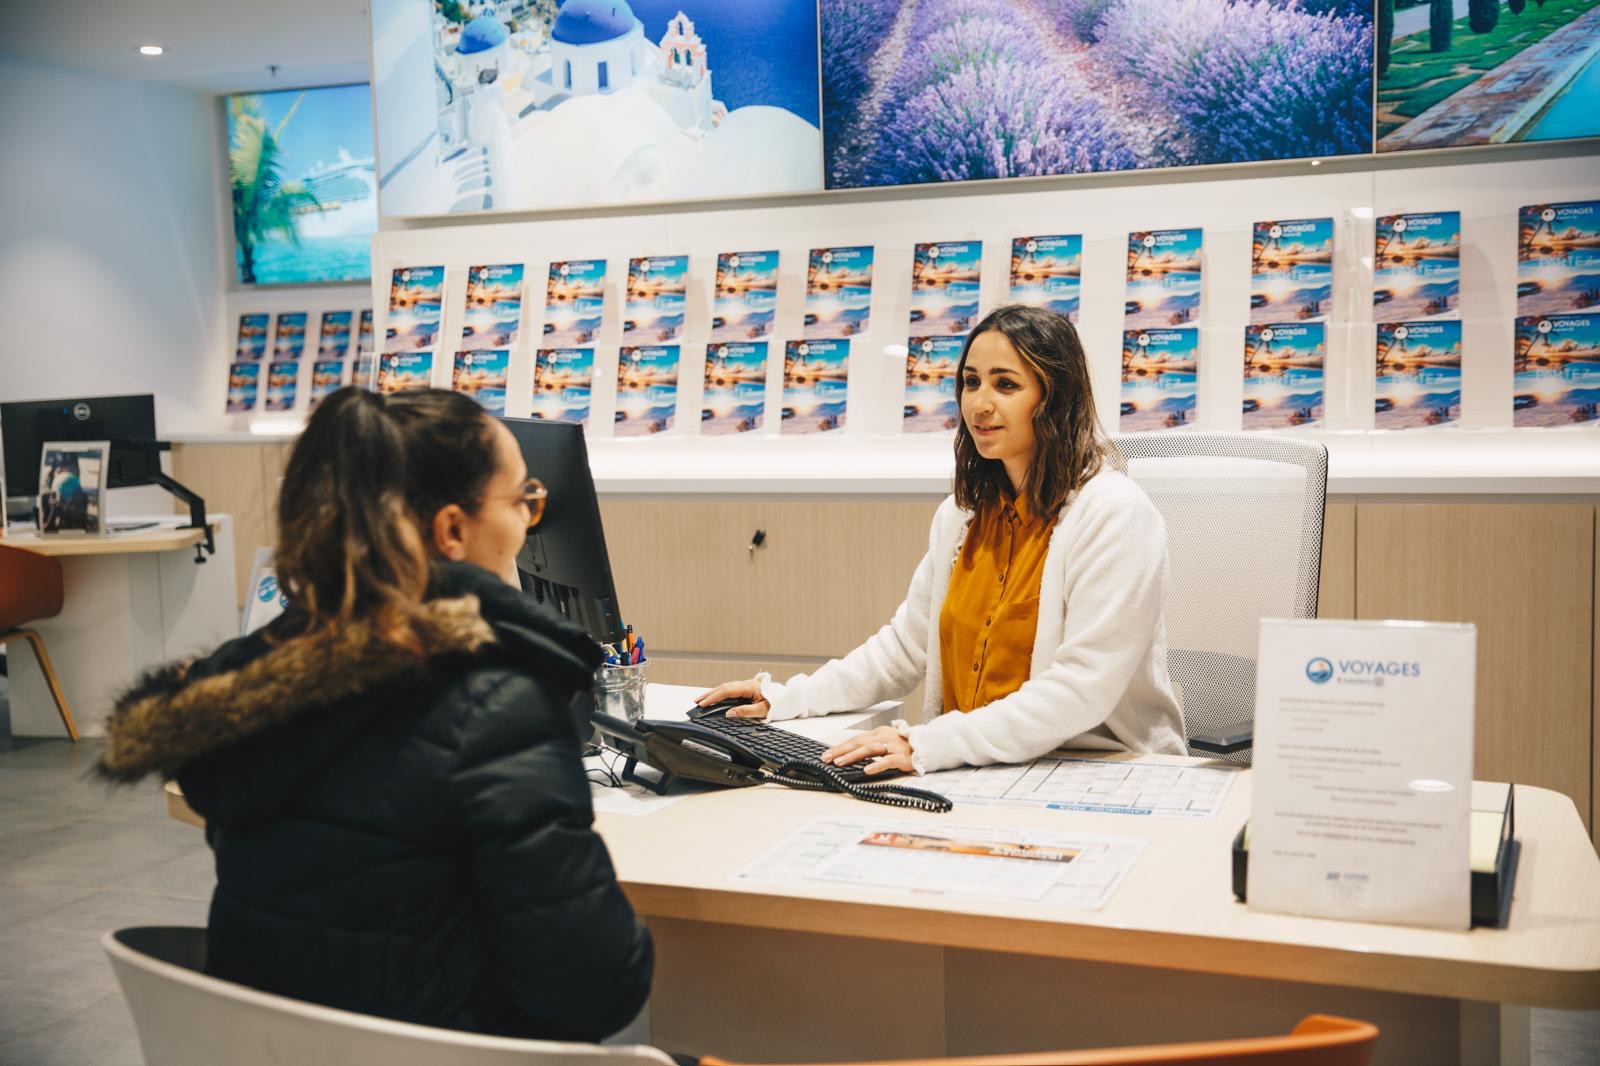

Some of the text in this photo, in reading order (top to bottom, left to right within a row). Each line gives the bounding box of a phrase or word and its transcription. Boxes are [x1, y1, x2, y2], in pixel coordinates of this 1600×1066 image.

[1557, 207, 1593, 216] VOYAGES
[1407, 218, 1442, 226] VOYAGES
[1283, 224, 1316, 232] VOYAGES
[1552, 319, 1590, 328] VOYAGES
[1274, 328, 1307, 336] VOYAGES
[1408, 326, 1444, 334] VOYAGES
[1338, 660, 1421, 677] VOYAGES
